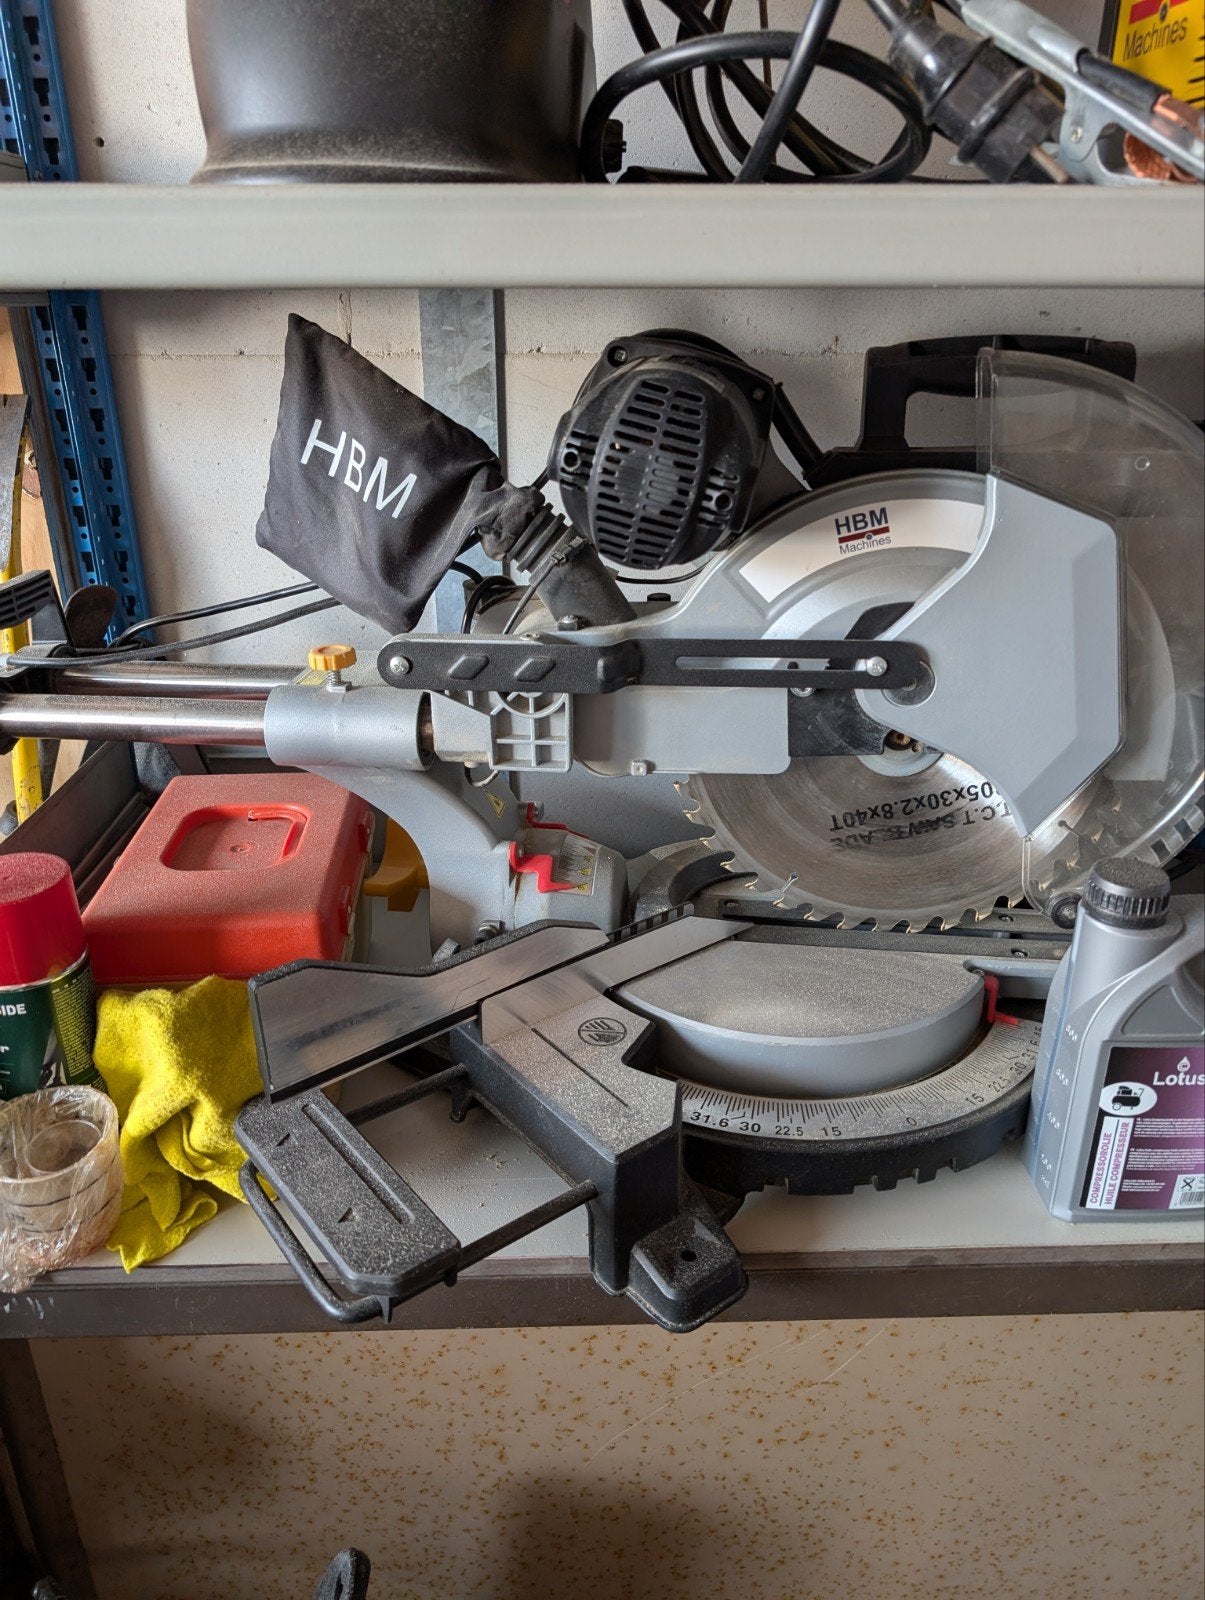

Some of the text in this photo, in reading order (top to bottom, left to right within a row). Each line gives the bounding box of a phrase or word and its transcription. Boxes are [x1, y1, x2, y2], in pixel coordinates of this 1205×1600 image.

[1123, 16, 1188, 61] Machines
[300, 418, 418, 519] HBM
[834, 506, 889, 536] HBM
[839, 536, 892, 555] Machines
[829, 781, 1000, 832] 05x30x2.8x40T
[0, 1003, 27, 1016] IDE
[690, 1111, 729, 1128] 31.6
[739, 1121, 762, 1133] 30
[774, 1125, 804, 1137] 22.5
[820, 1126, 842, 1138] 15
[905, 1116, 918, 1127] 0
[965, 1093, 985, 1106] 15
[1009, 1061, 1027, 1075] 30
[1152, 1071, 1204, 1086] Lotus
[1090, 1132, 1112, 1204] COMPRESSOROLIE
[1104, 1121, 1130, 1205] HUILE COMPRESSEUR
